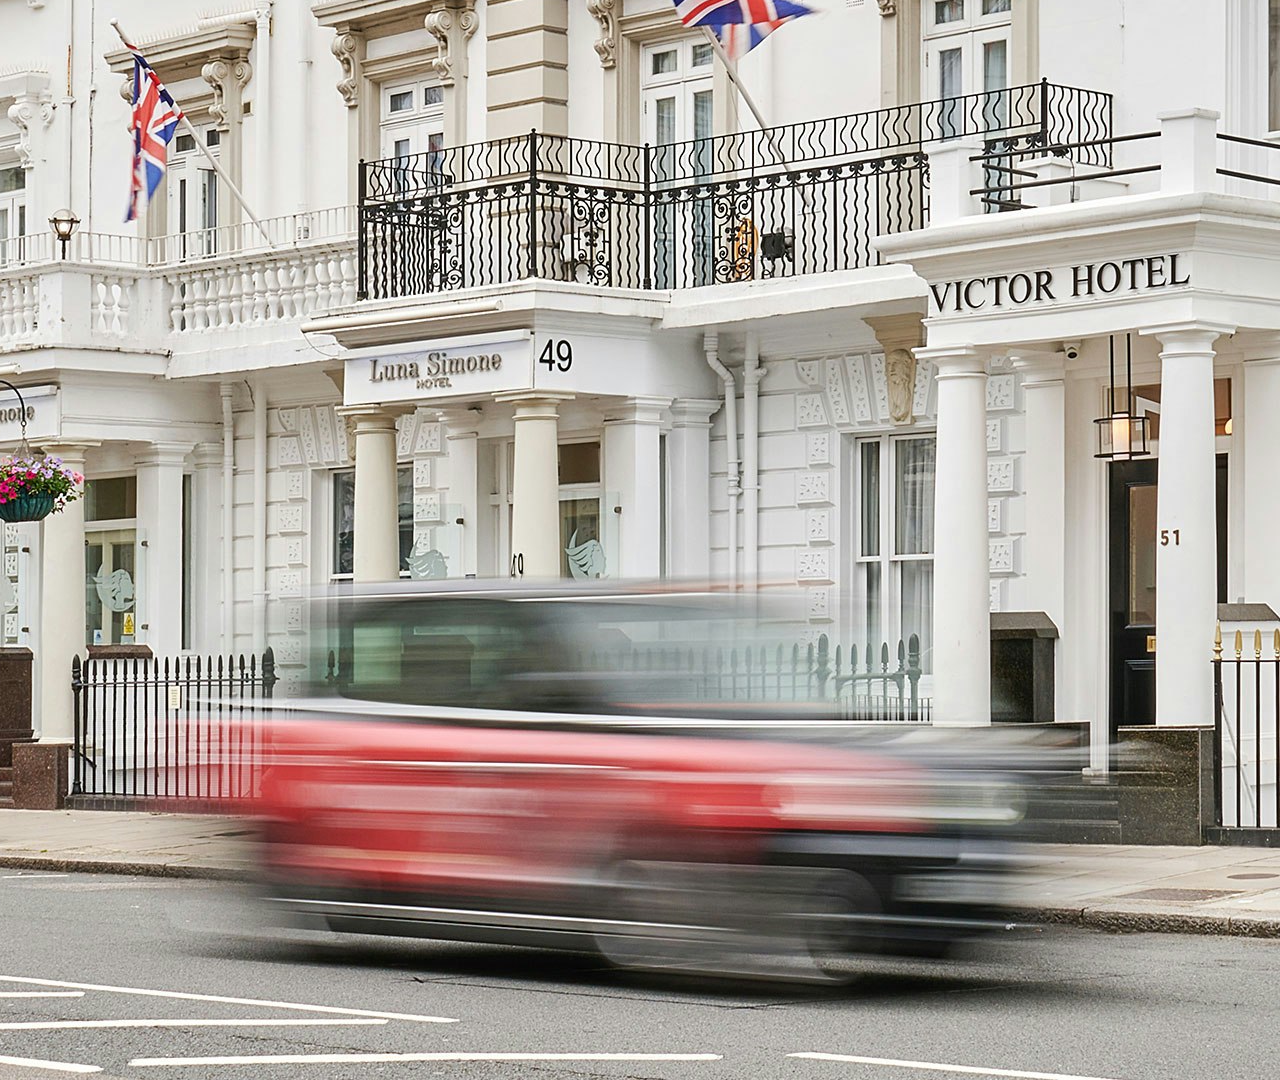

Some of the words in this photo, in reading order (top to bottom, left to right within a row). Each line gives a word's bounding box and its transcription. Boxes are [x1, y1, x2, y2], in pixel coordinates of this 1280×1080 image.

[930, 270, 1056, 312] VICTOR
[1070, 253, 1190, 296] HOTEL
[370, 359, 420, 383] Luna
[427, 352, 502, 376] Simone
[539, 339, 572, 372] 49
[416, 377, 452, 389] HOTEL
[1160, 529, 1179, 546] 51
